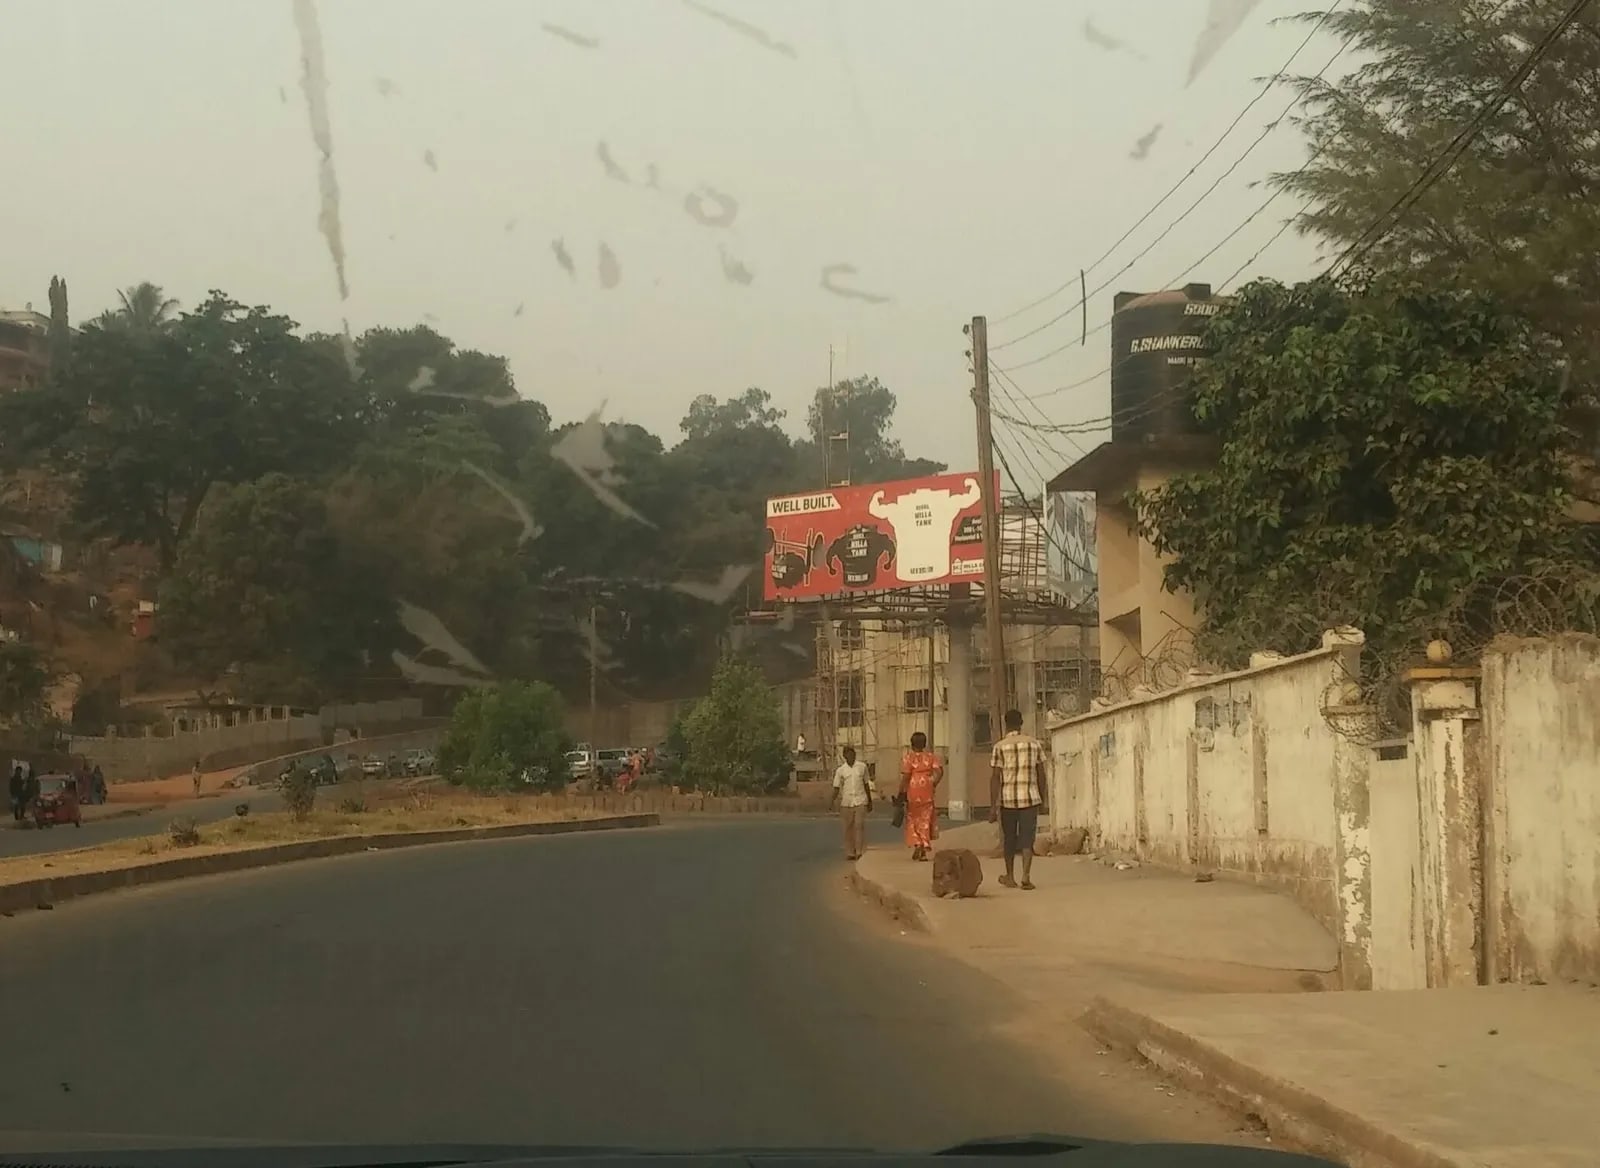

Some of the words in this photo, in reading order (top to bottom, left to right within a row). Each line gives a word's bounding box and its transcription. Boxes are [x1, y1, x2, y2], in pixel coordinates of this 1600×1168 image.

[772, 500, 802, 514] WELL
[803, 495, 834, 510] BUILT.
[915, 518, 932, 527] TANK
